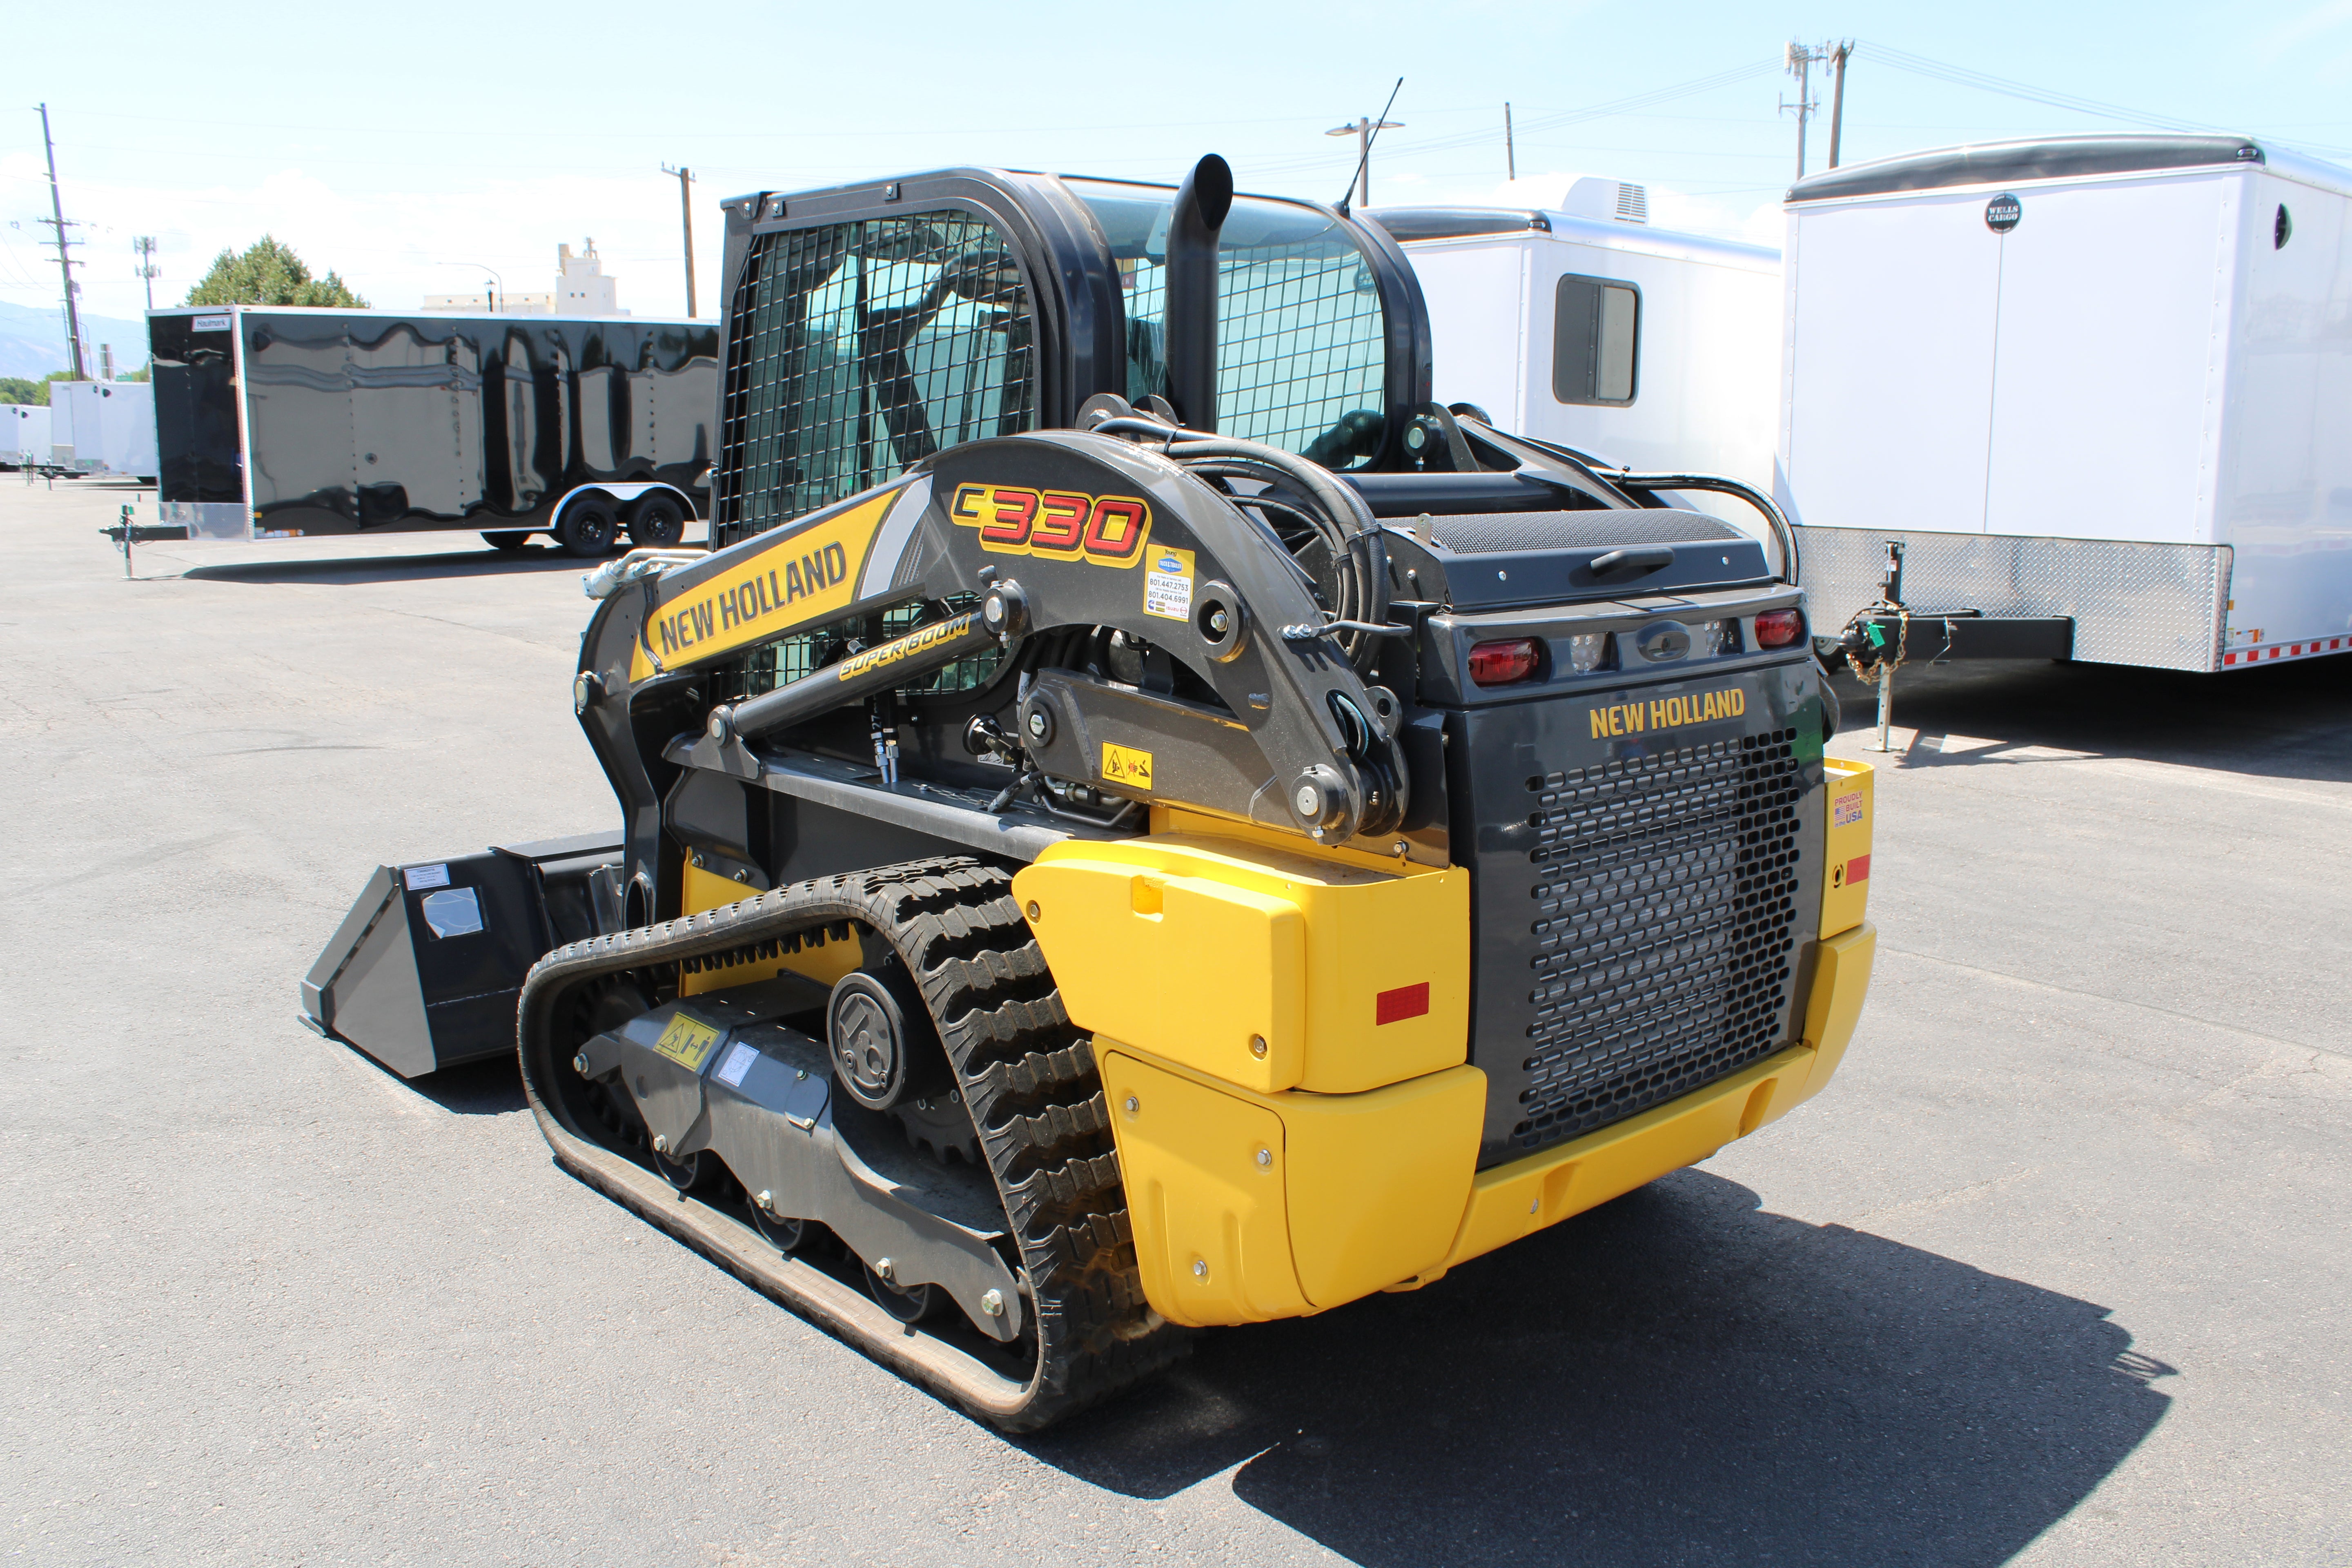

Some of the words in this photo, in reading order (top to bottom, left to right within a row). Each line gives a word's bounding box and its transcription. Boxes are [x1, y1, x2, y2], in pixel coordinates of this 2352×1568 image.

[1989, 205, 2019, 214] WELLS
[1988, 213, 2018, 222] CARGO
[197, 319, 226, 327] Haulmark
[1165, 549, 1177, 557] Young
[1150, 578, 1189, 592] 801.447.2753
[659, 598, 715, 657] NEW
[718, 540, 848, 632] HOLLAND
[1148, 590, 1188, 604] 801.404.6991
[841, 638, 905, 678] SUPER
[907, 614, 971, 654] BOOM
[1590, 702, 1644, 739] NEW
[1650, 688, 1745, 730] HOLLAND
[1835, 791, 1862, 806] PROUDLY
[1846, 800, 1862, 812] BUILT
[1846, 810, 1862, 824] USA
